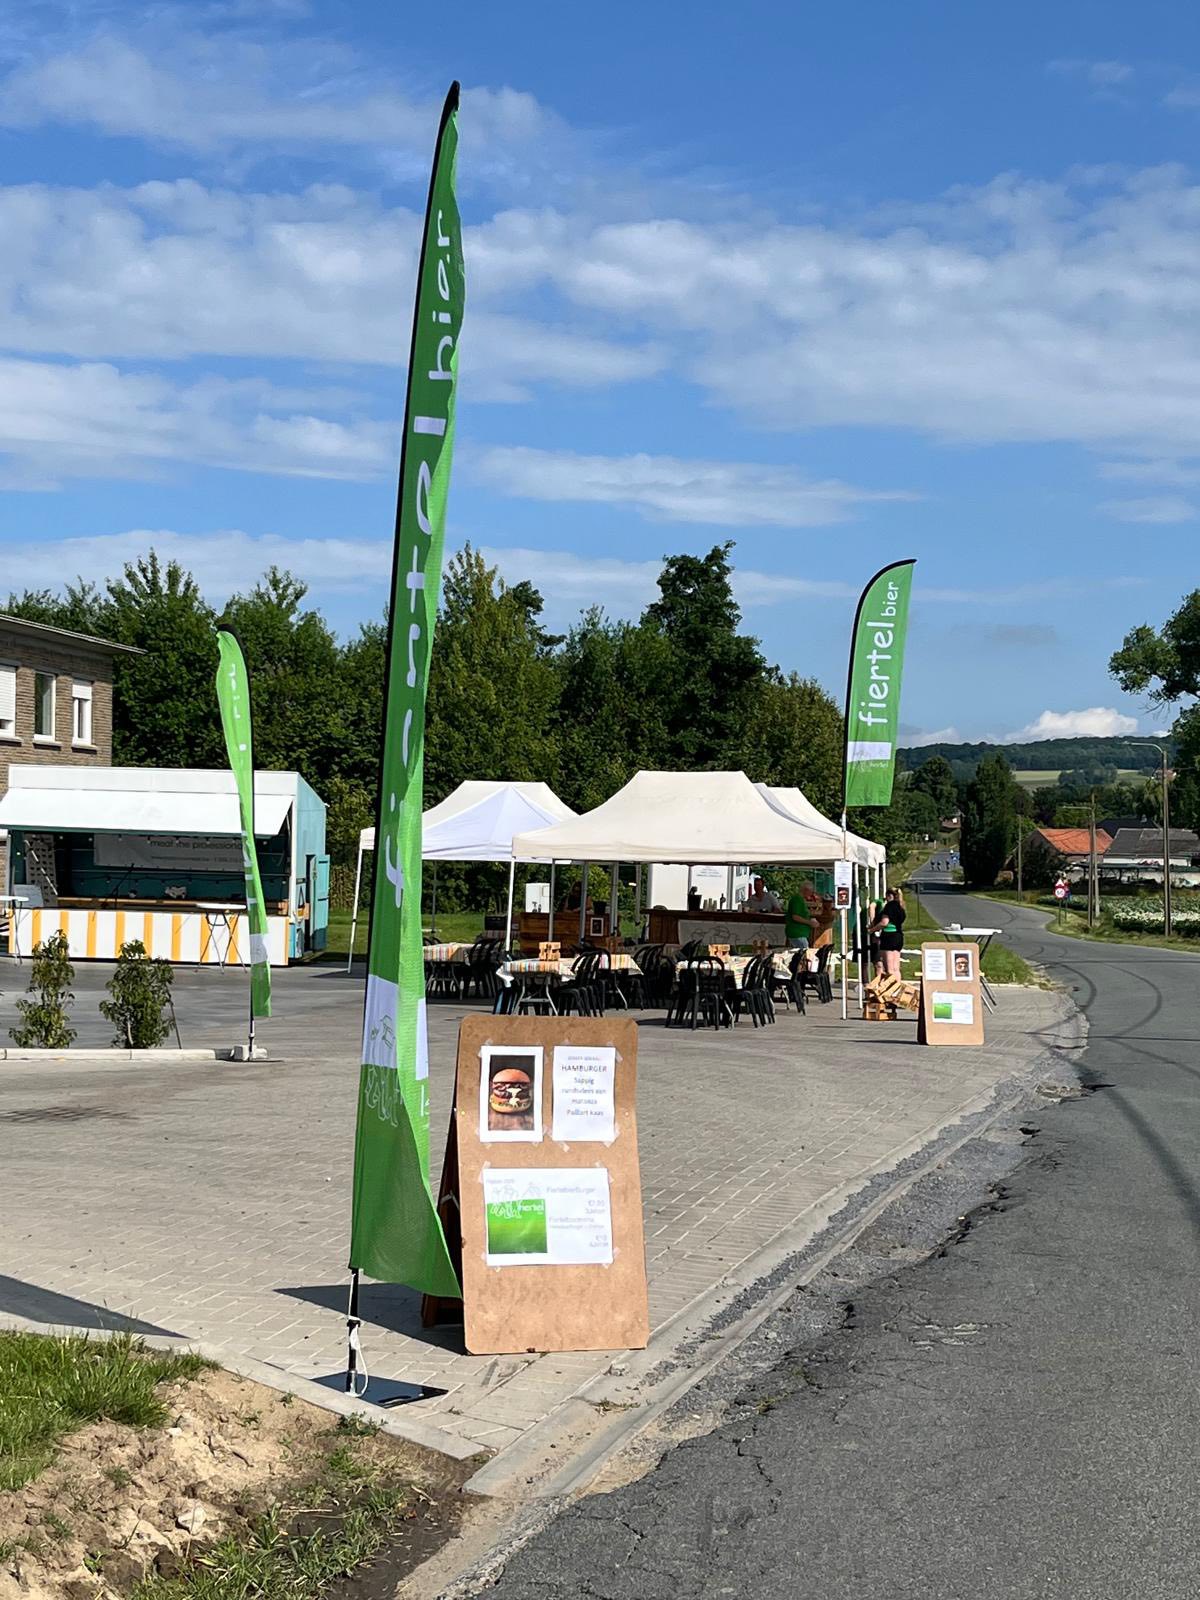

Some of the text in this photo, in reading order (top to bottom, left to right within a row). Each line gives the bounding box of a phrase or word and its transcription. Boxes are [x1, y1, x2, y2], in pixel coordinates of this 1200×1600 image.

[386, 415, 447, 909] frtel
[858, 581, 899, 727] fiertel bier
[192, 840, 243, 850] professiona
[561, 1064, 608, 1073] HAMBURGER
